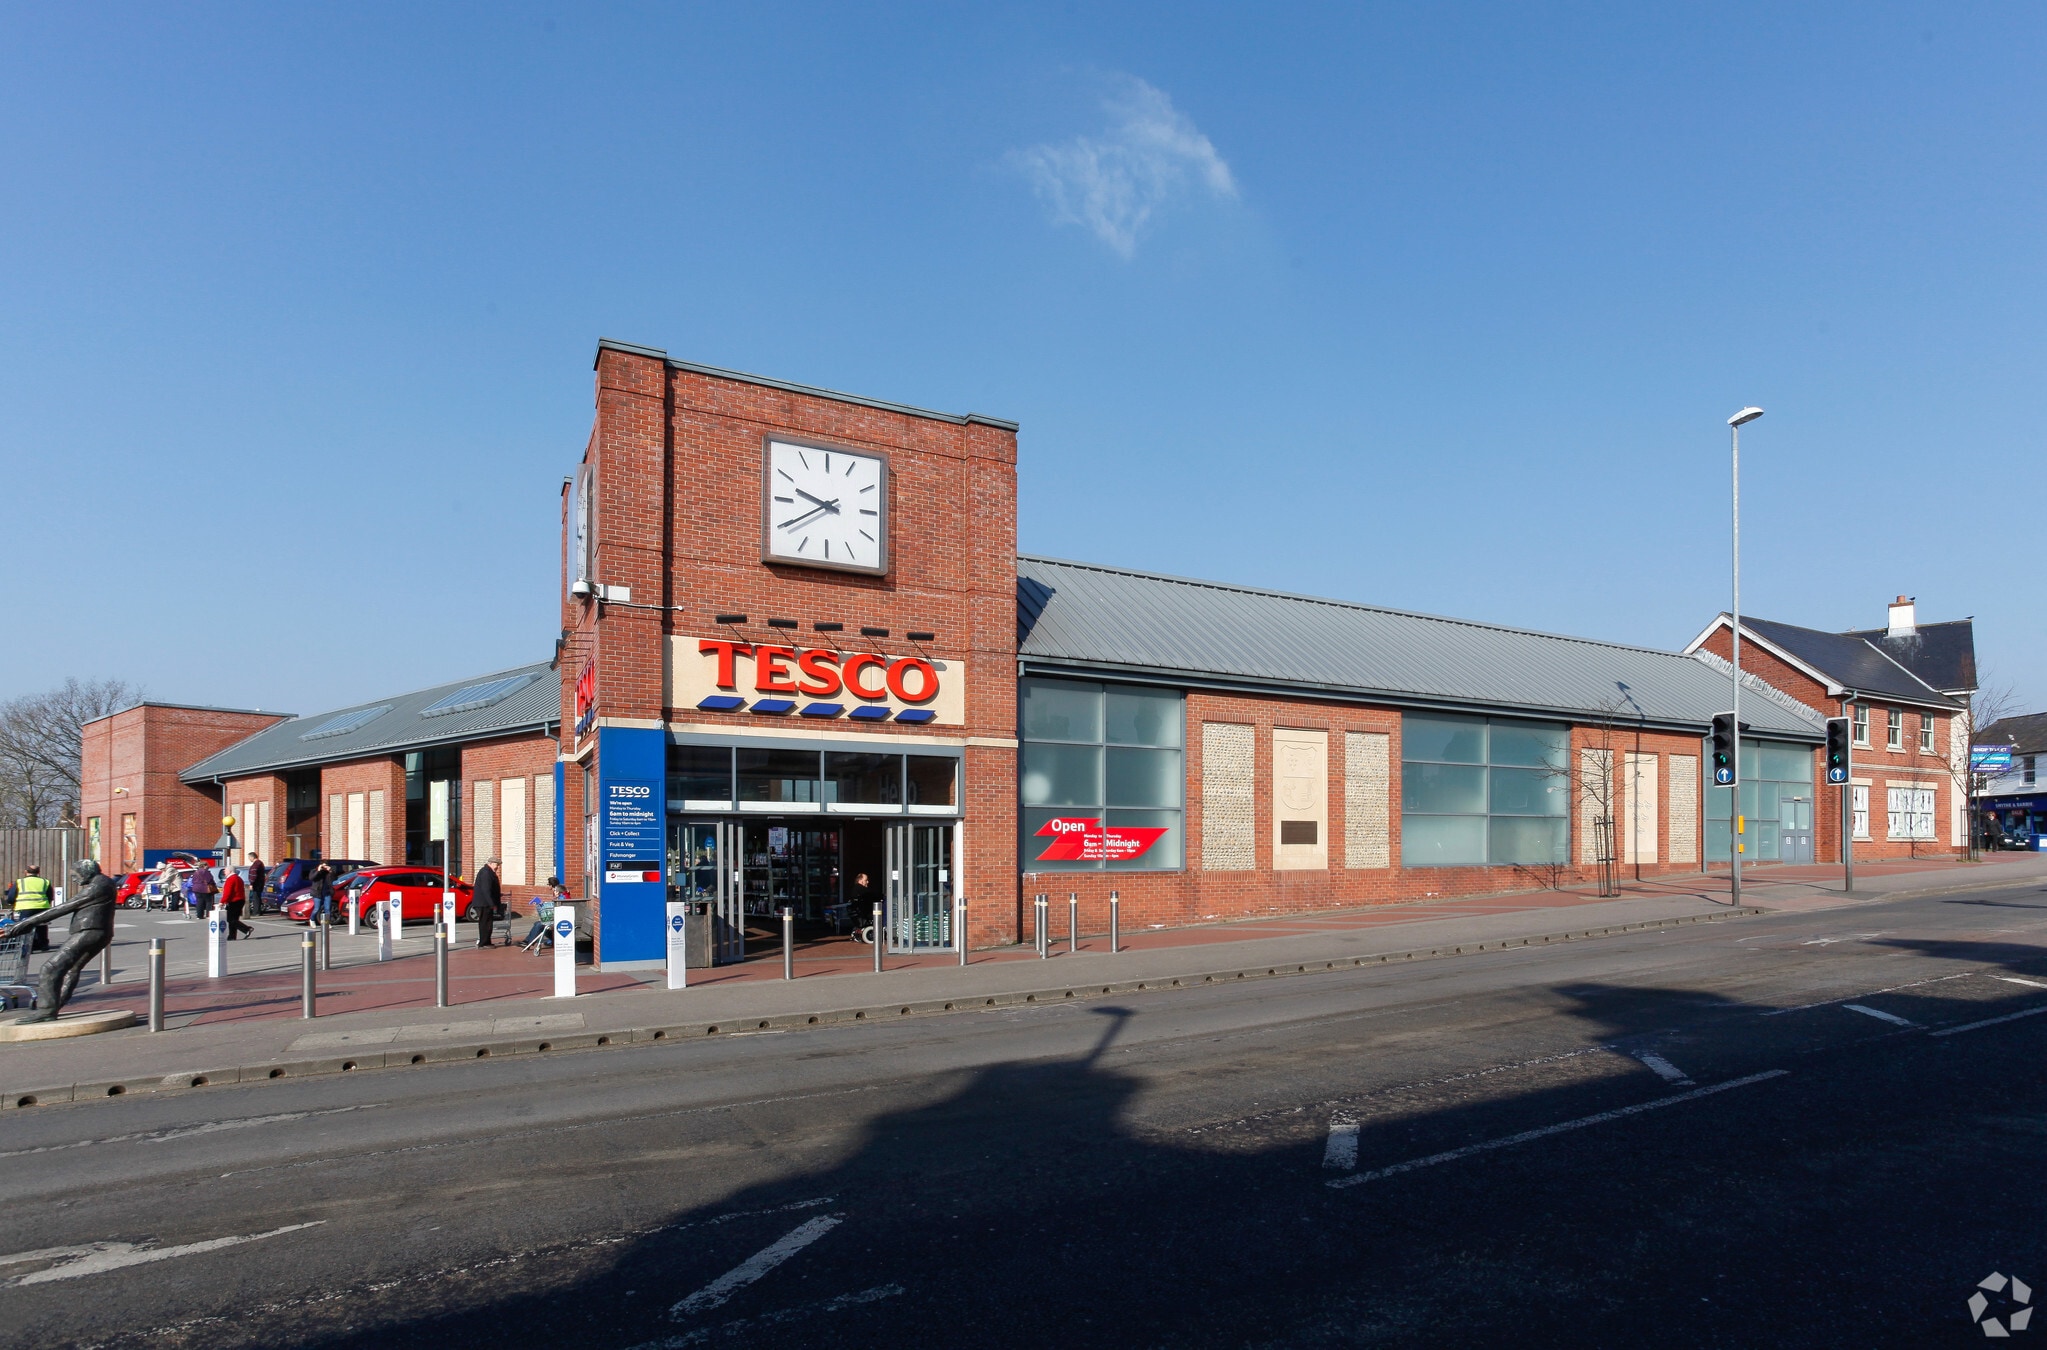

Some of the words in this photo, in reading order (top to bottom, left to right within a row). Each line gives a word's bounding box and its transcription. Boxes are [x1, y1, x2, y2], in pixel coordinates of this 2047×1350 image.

[699, 640, 939, 701] TESCO
[609, 786, 650, 795] TESCO
[1051, 819, 1085, 834] Open
[1106, 839, 1140, 848] Midnight
